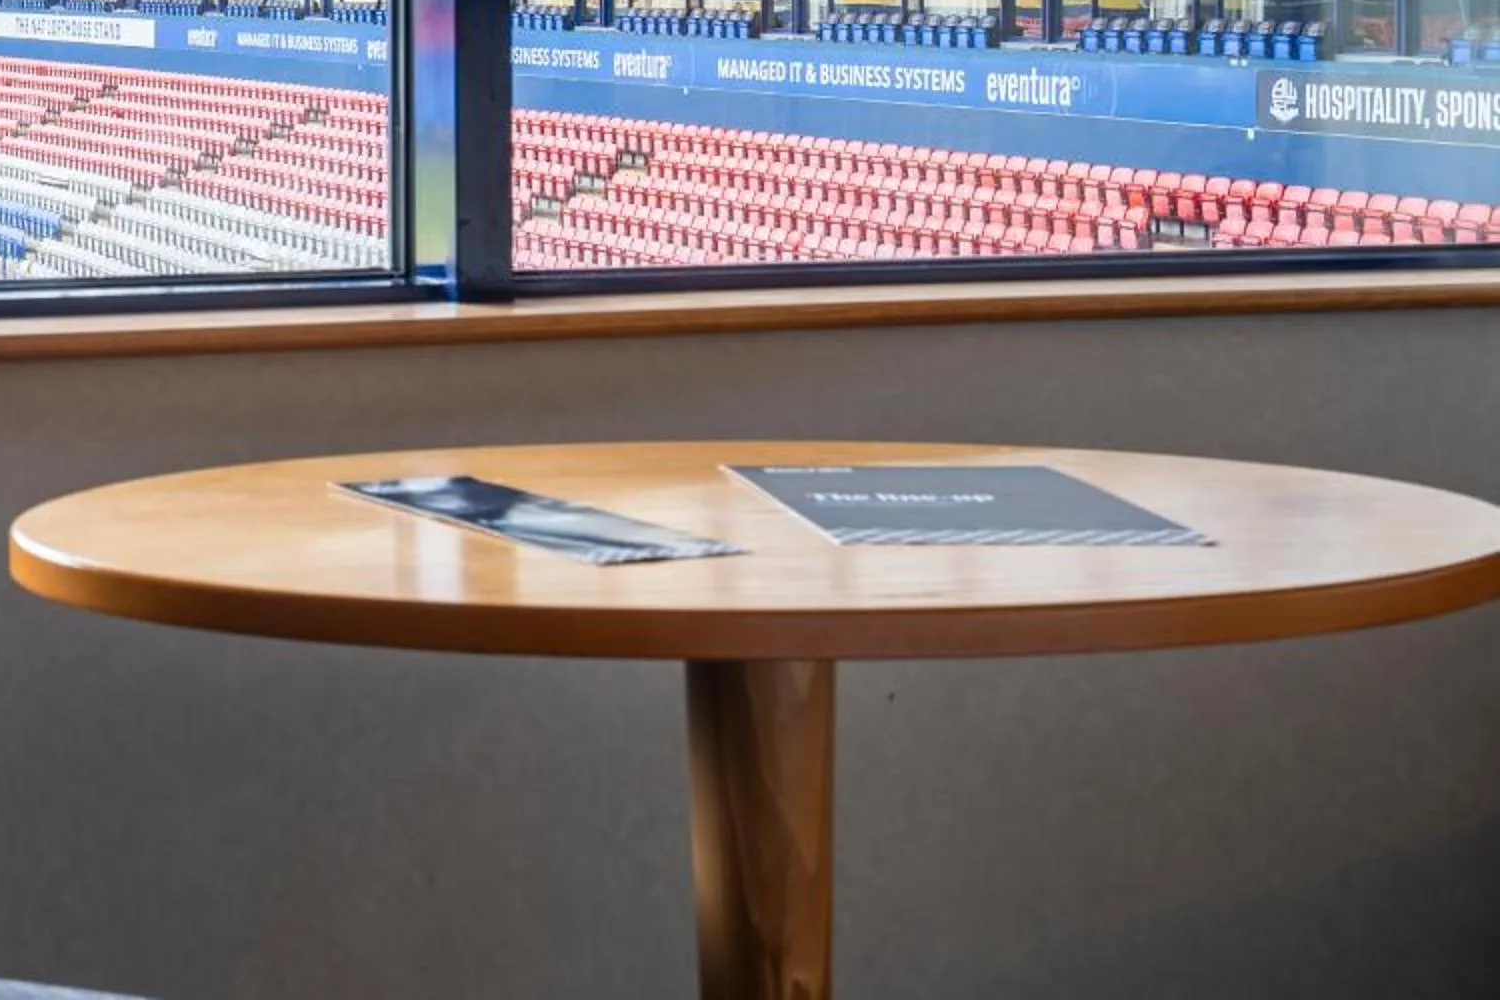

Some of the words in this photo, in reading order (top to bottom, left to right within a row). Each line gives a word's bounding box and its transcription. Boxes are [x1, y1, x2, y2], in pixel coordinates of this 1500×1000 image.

[93, 21, 121, 40] STAND
[551, 48, 600, 69] SYSTEMS
[717, 57, 786, 82] MANAGED
[789, 61, 803, 83] IT
[805, 63, 816, 84] &
[820, 63, 891, 88] BUSINESS
[894, 67, 965, 93] SYSTEMS
[1305, 83, 1430, 128] HOSPITALITY,
